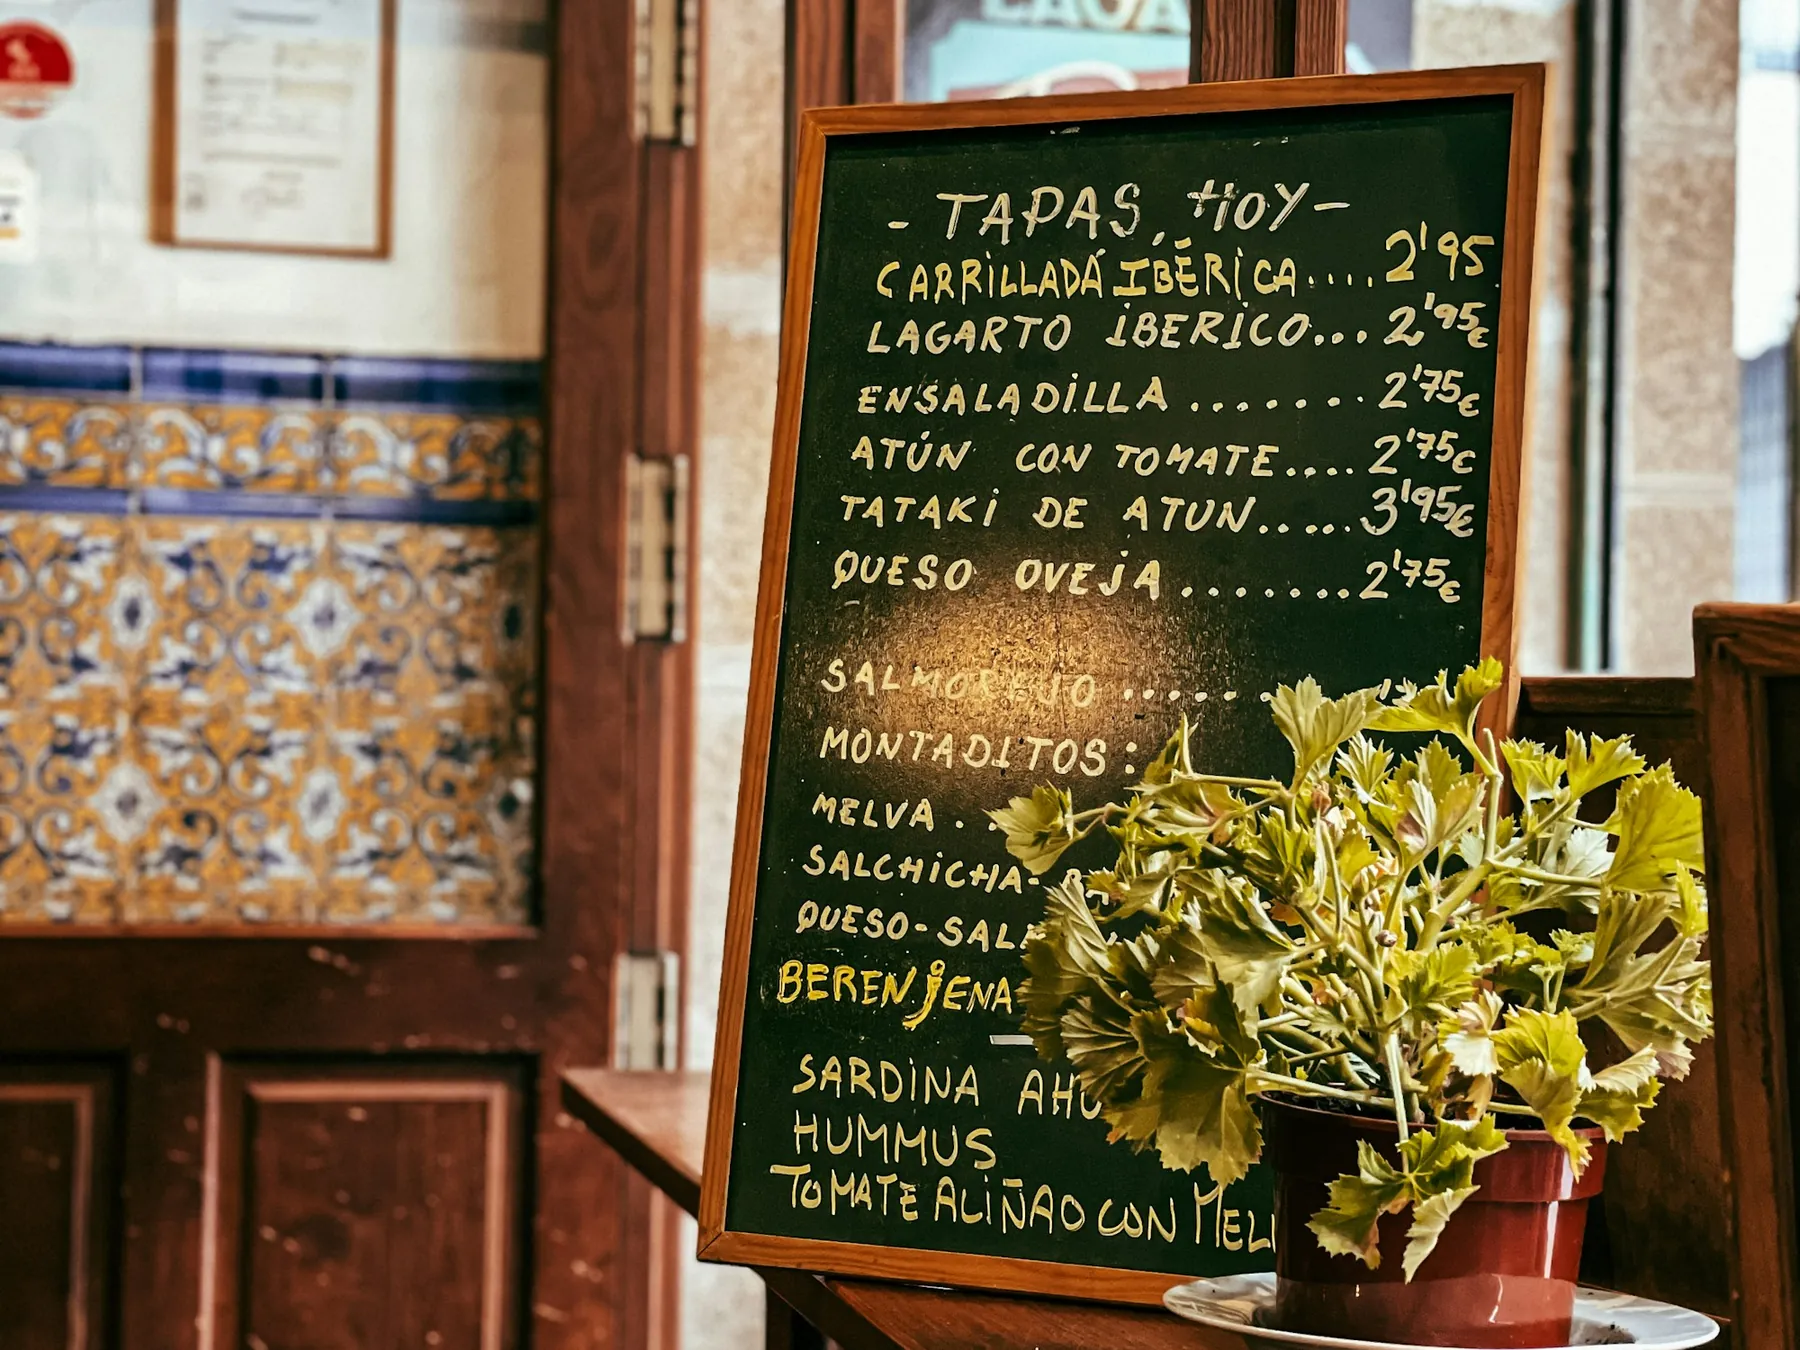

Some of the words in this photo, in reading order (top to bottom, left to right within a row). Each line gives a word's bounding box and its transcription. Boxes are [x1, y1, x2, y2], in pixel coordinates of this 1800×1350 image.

[936, 182, 1141, 246] TAPAS
[1186, 178, 1310, 233] HOY
[867, 314, 1072, 355] LAGARTO
[857, 372, 1168, 417] ENSALADILLA
[1015, 443, 1093, 474] CON
[1115, 443, 1280, 477] TOMATE
[841, 487, 1001, 530] TATAKI
[1032, 496, 1089, 529] DE
[1122, 495, 1257, 532] ATUN
[831, 550, 977, 592] QUESO
[812, 792, 935, 832] MELVA
[792, 1053, 979, 1106] SARDINA
[792, 1108, 998, 1170] HUMMUS
[769, 1163, 919, 1222] TOMATE
[1098, 1196, 1176, 1243] CON
